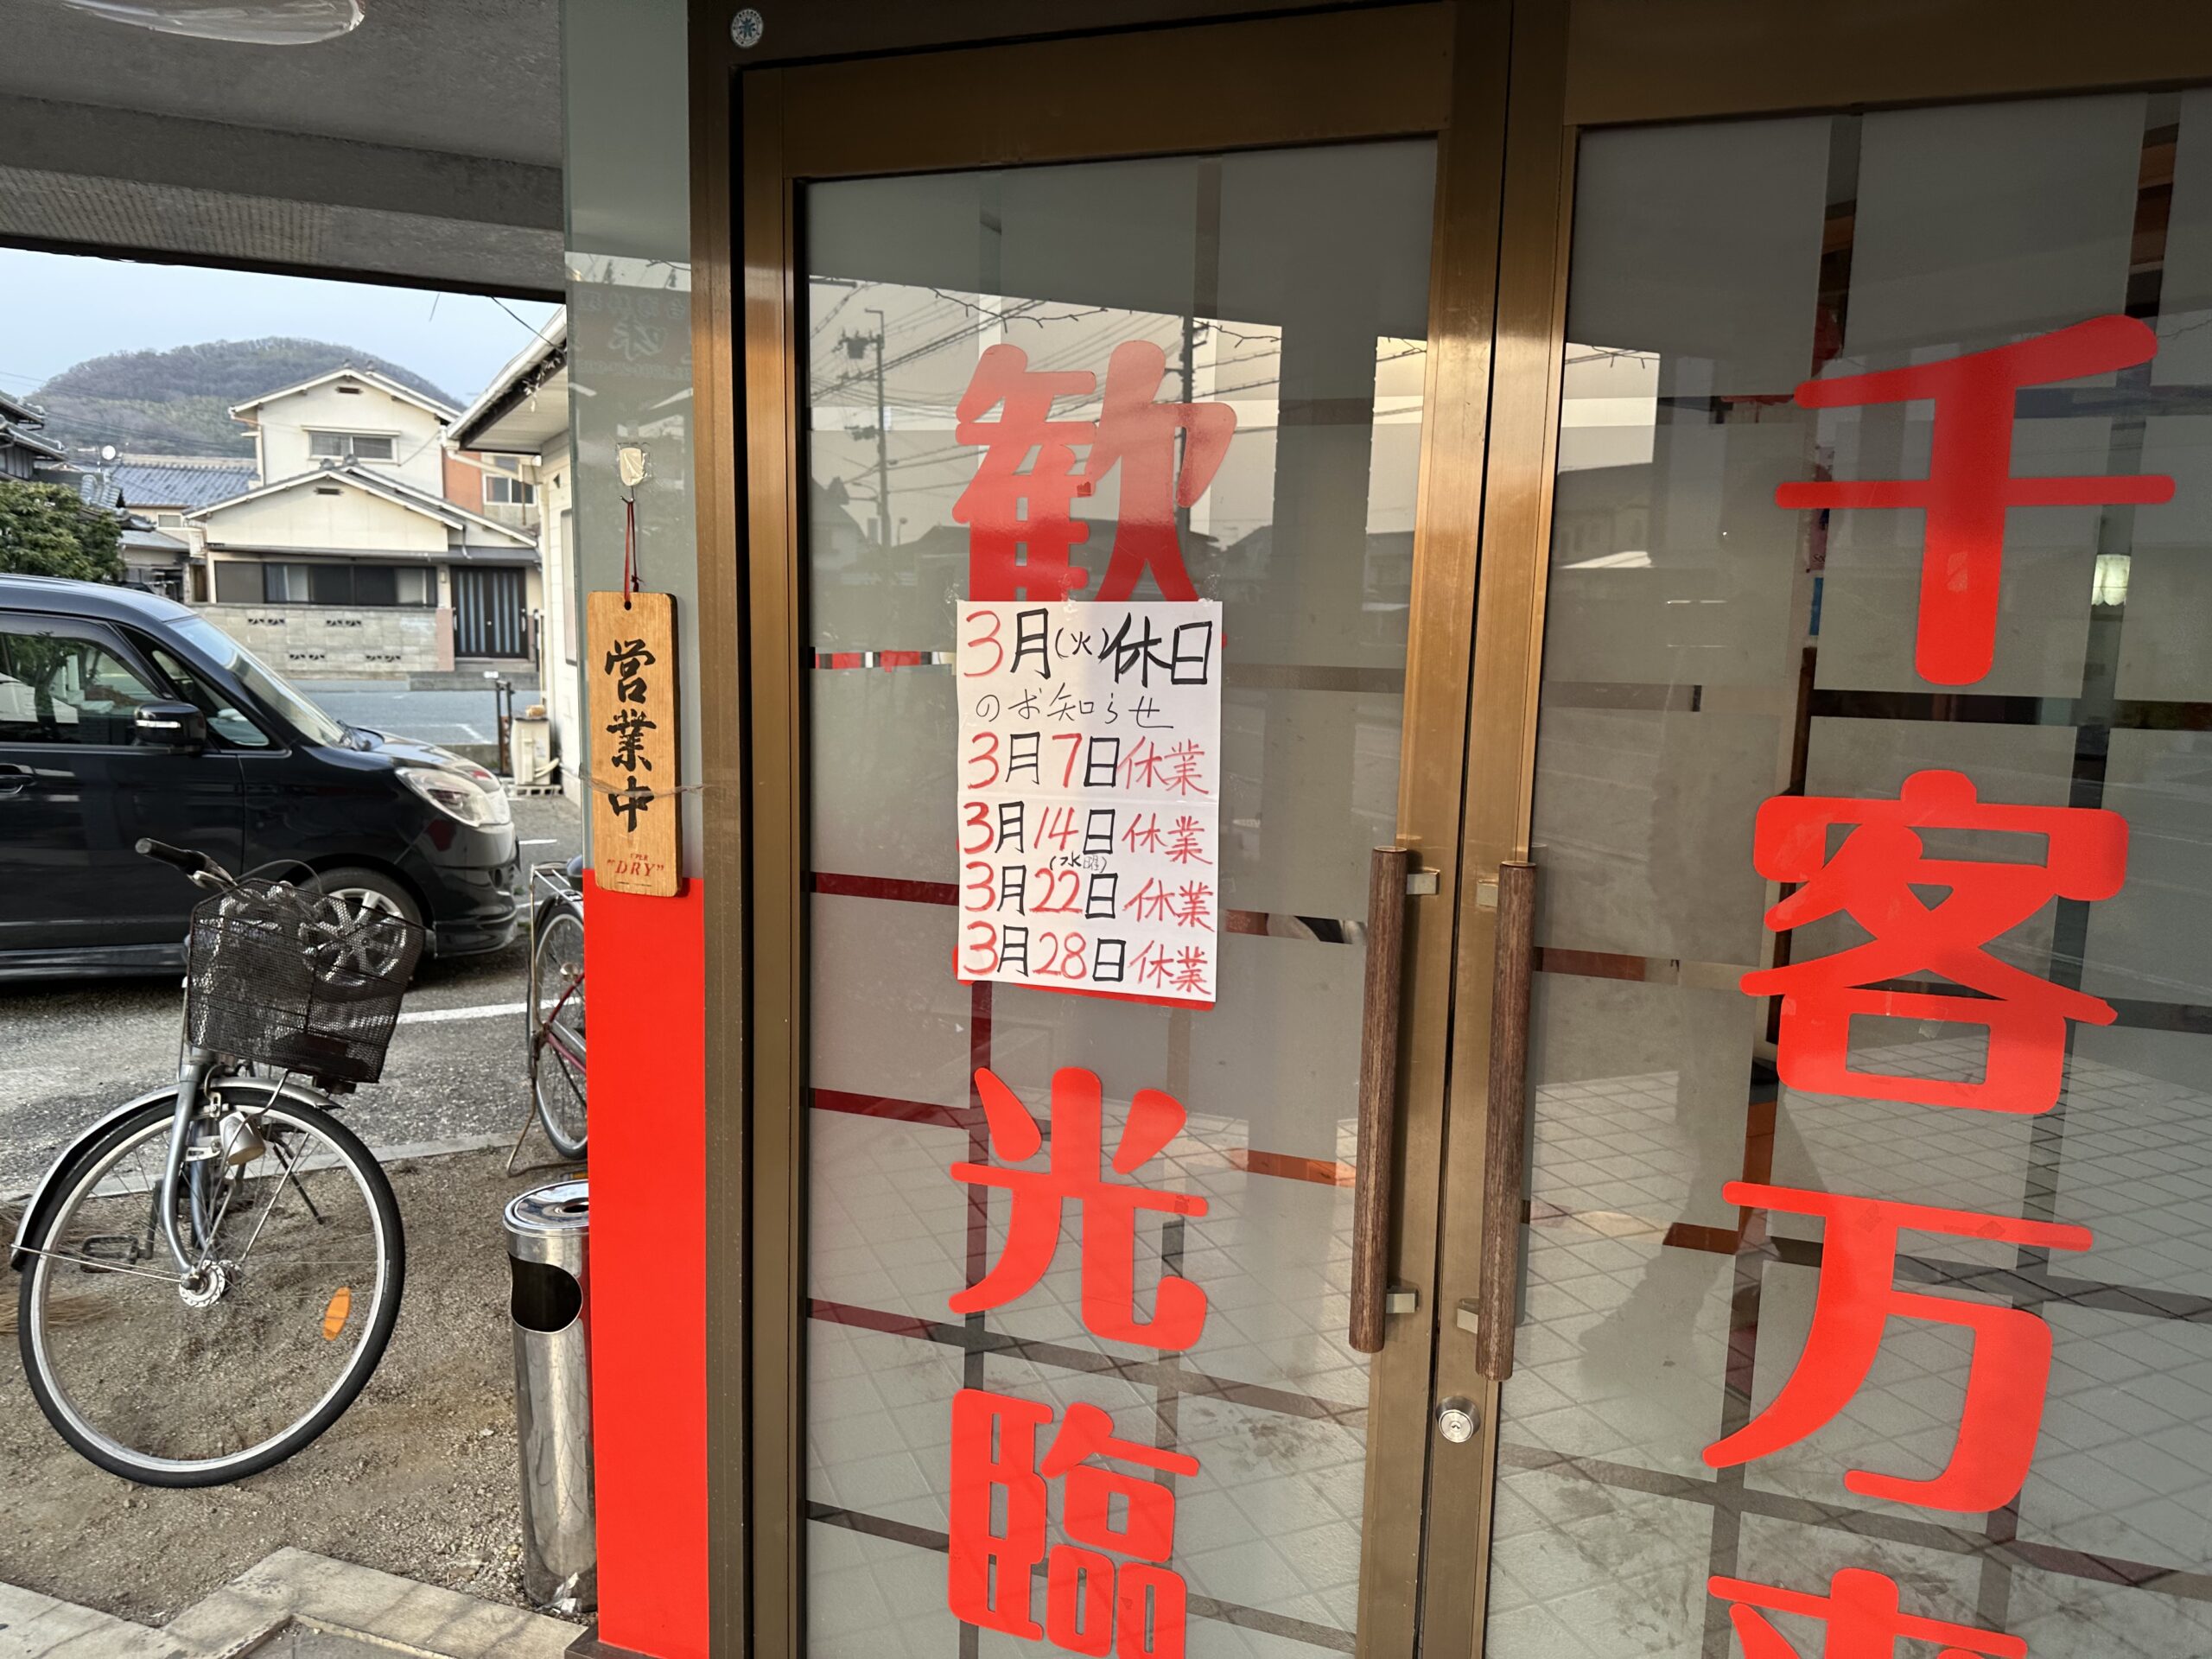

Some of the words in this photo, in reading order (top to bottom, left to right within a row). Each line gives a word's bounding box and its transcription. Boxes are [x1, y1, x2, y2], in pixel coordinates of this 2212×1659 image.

[604, 639, 657, 833] 営業中
[976, 682, 1174, 729] のお知らせ
[966, 731, 1210, 796] 3月7日休業
[963, 800, 1213, 866] 3月14日休業
[964, 861, 1215, 933] 3月22日休業
[963, 919, 1212, 995] 3月28日休業
[1703, 314, 2176, 1659] 千客万
[948, 340, 1238, 1659] 歓光臨
